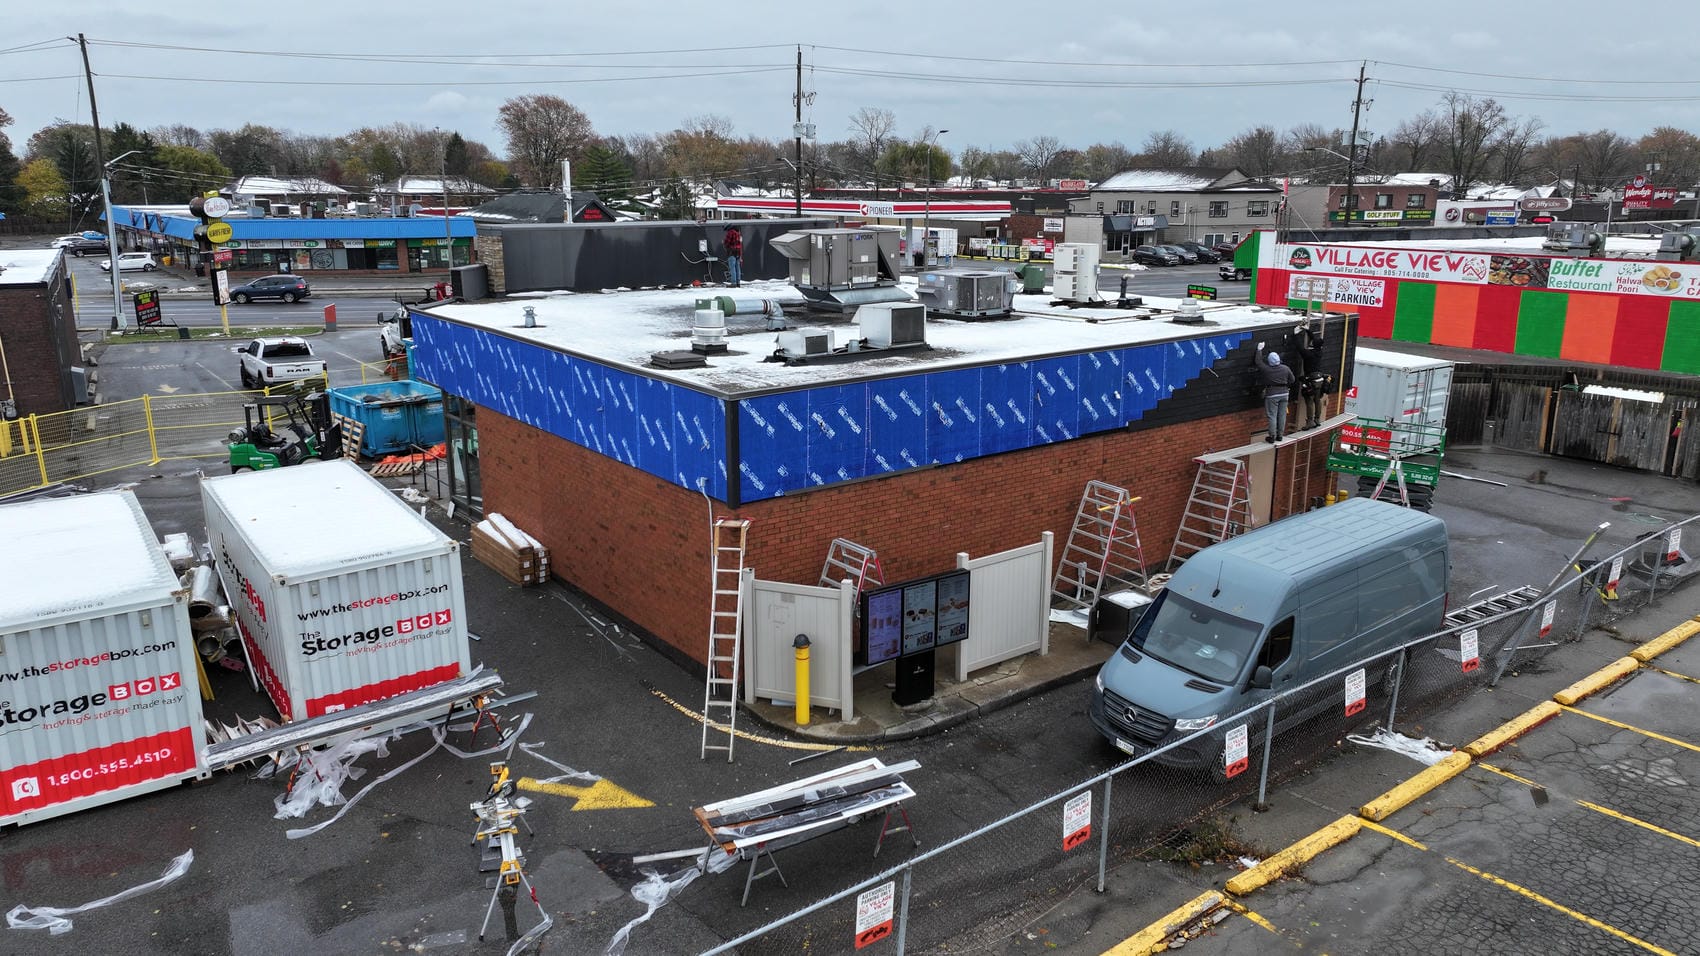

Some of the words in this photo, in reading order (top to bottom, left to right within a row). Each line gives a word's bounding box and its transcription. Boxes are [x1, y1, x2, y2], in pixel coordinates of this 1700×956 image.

[1626, 187, 1651, 198] Wendy's
[869, 206, 893, 216] PIONEER
[1315, 248, 1401, 269] VILLAGE
[1408, 253, 1465, 273] VIEW
[1551, 260, 1603, 277] Buffet
[1351, 280, 1383, 288] VILLAGE
[1548, 277, 1613, 292] Restaurant
[1616, 276, 1642, 285] Halwa
[1617, 284, 1639, 293] Poori
[1334, 292, 1376, 305] PARKING
[297, 584, 449, 622] www.thestoragebox.com
[301, 625, 394, 656] Storage
[399, 610, 450, 633] BOX
[112, 674, 179, 700] BOX
[862, 883, 891, 899] AUTHORIZED
[862, 894, 880, 905] PARKING
[869, 894, 892, 908] VILLAGE
